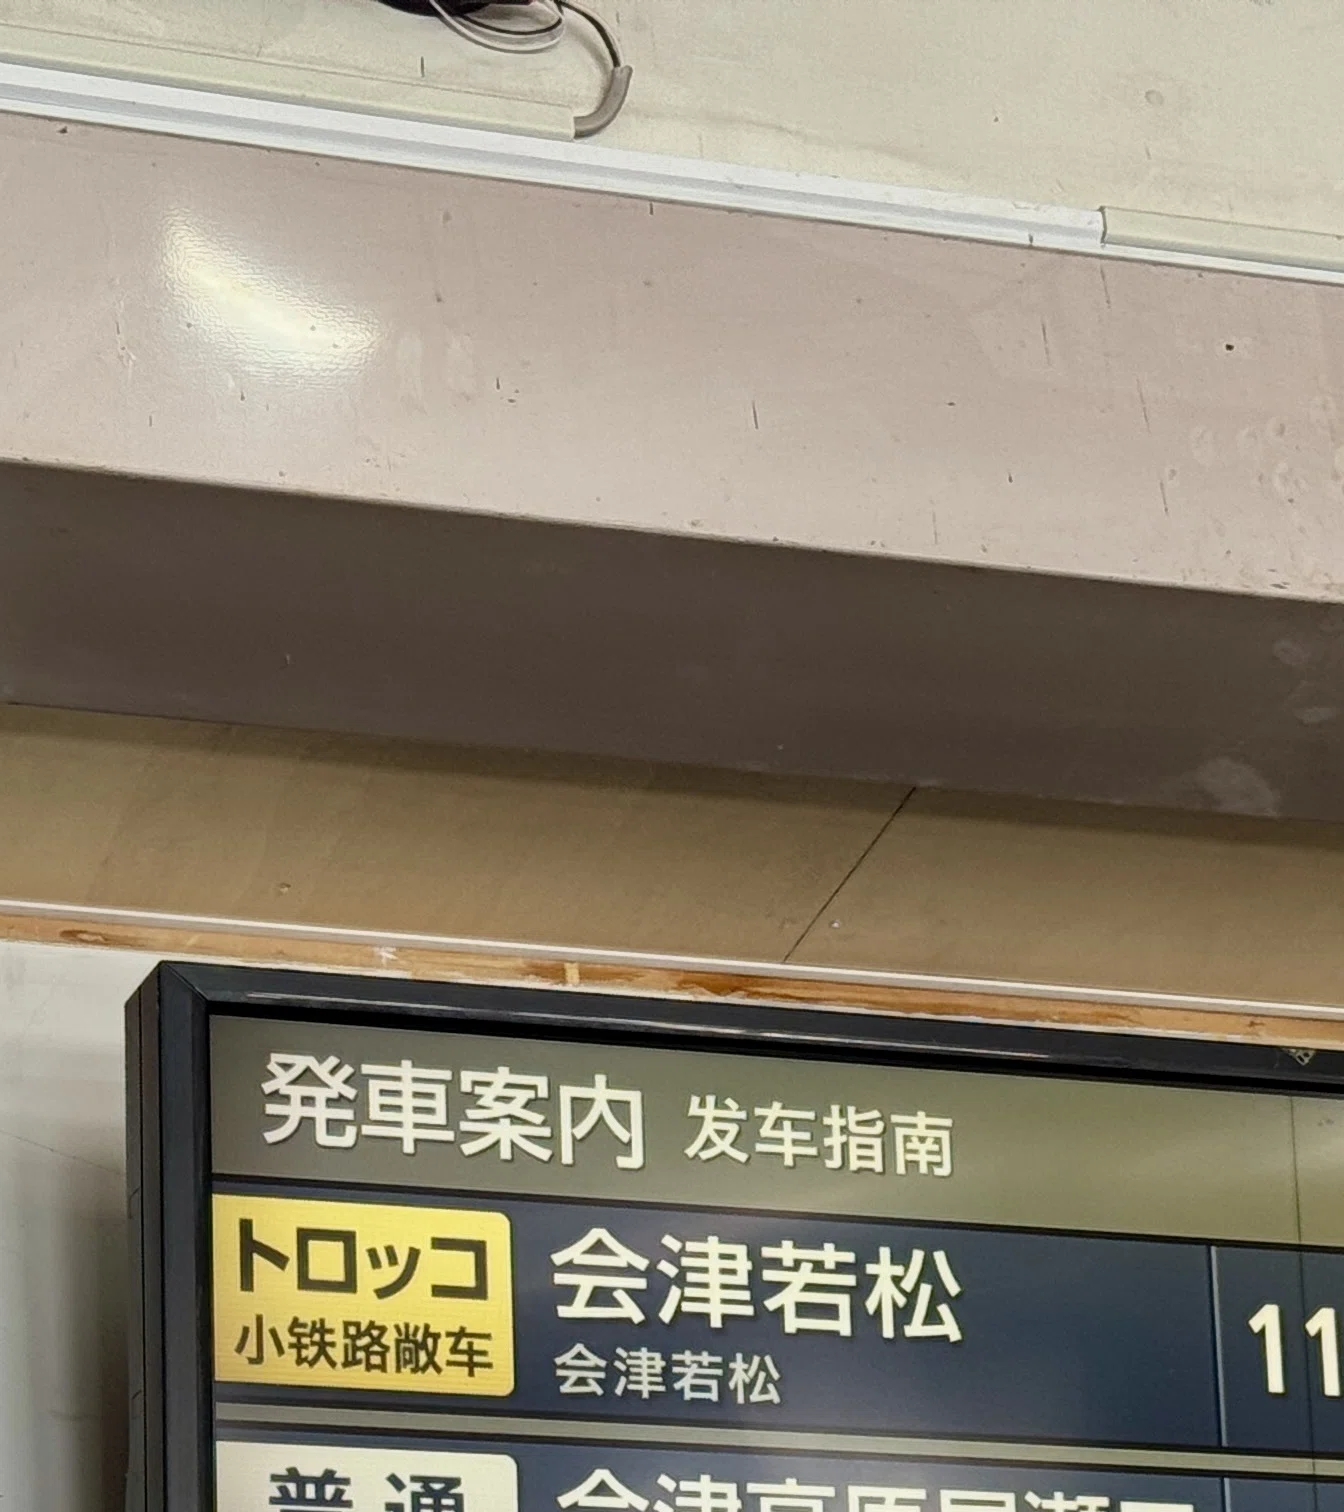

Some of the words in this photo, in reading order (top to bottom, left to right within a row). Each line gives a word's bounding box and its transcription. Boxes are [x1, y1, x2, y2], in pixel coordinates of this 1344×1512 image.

[260, 1053, 646, 1171] 発車案内
[684, 1095, 954, 1178] 发车指南
[236, 1217, 491, 1303] トロッコ
[550, 1226, 962, 1344] 会津若松
[234, 1313, 494, 1378] 小铁路敞车
[553, 1343, 781, 1405] 会津若松
